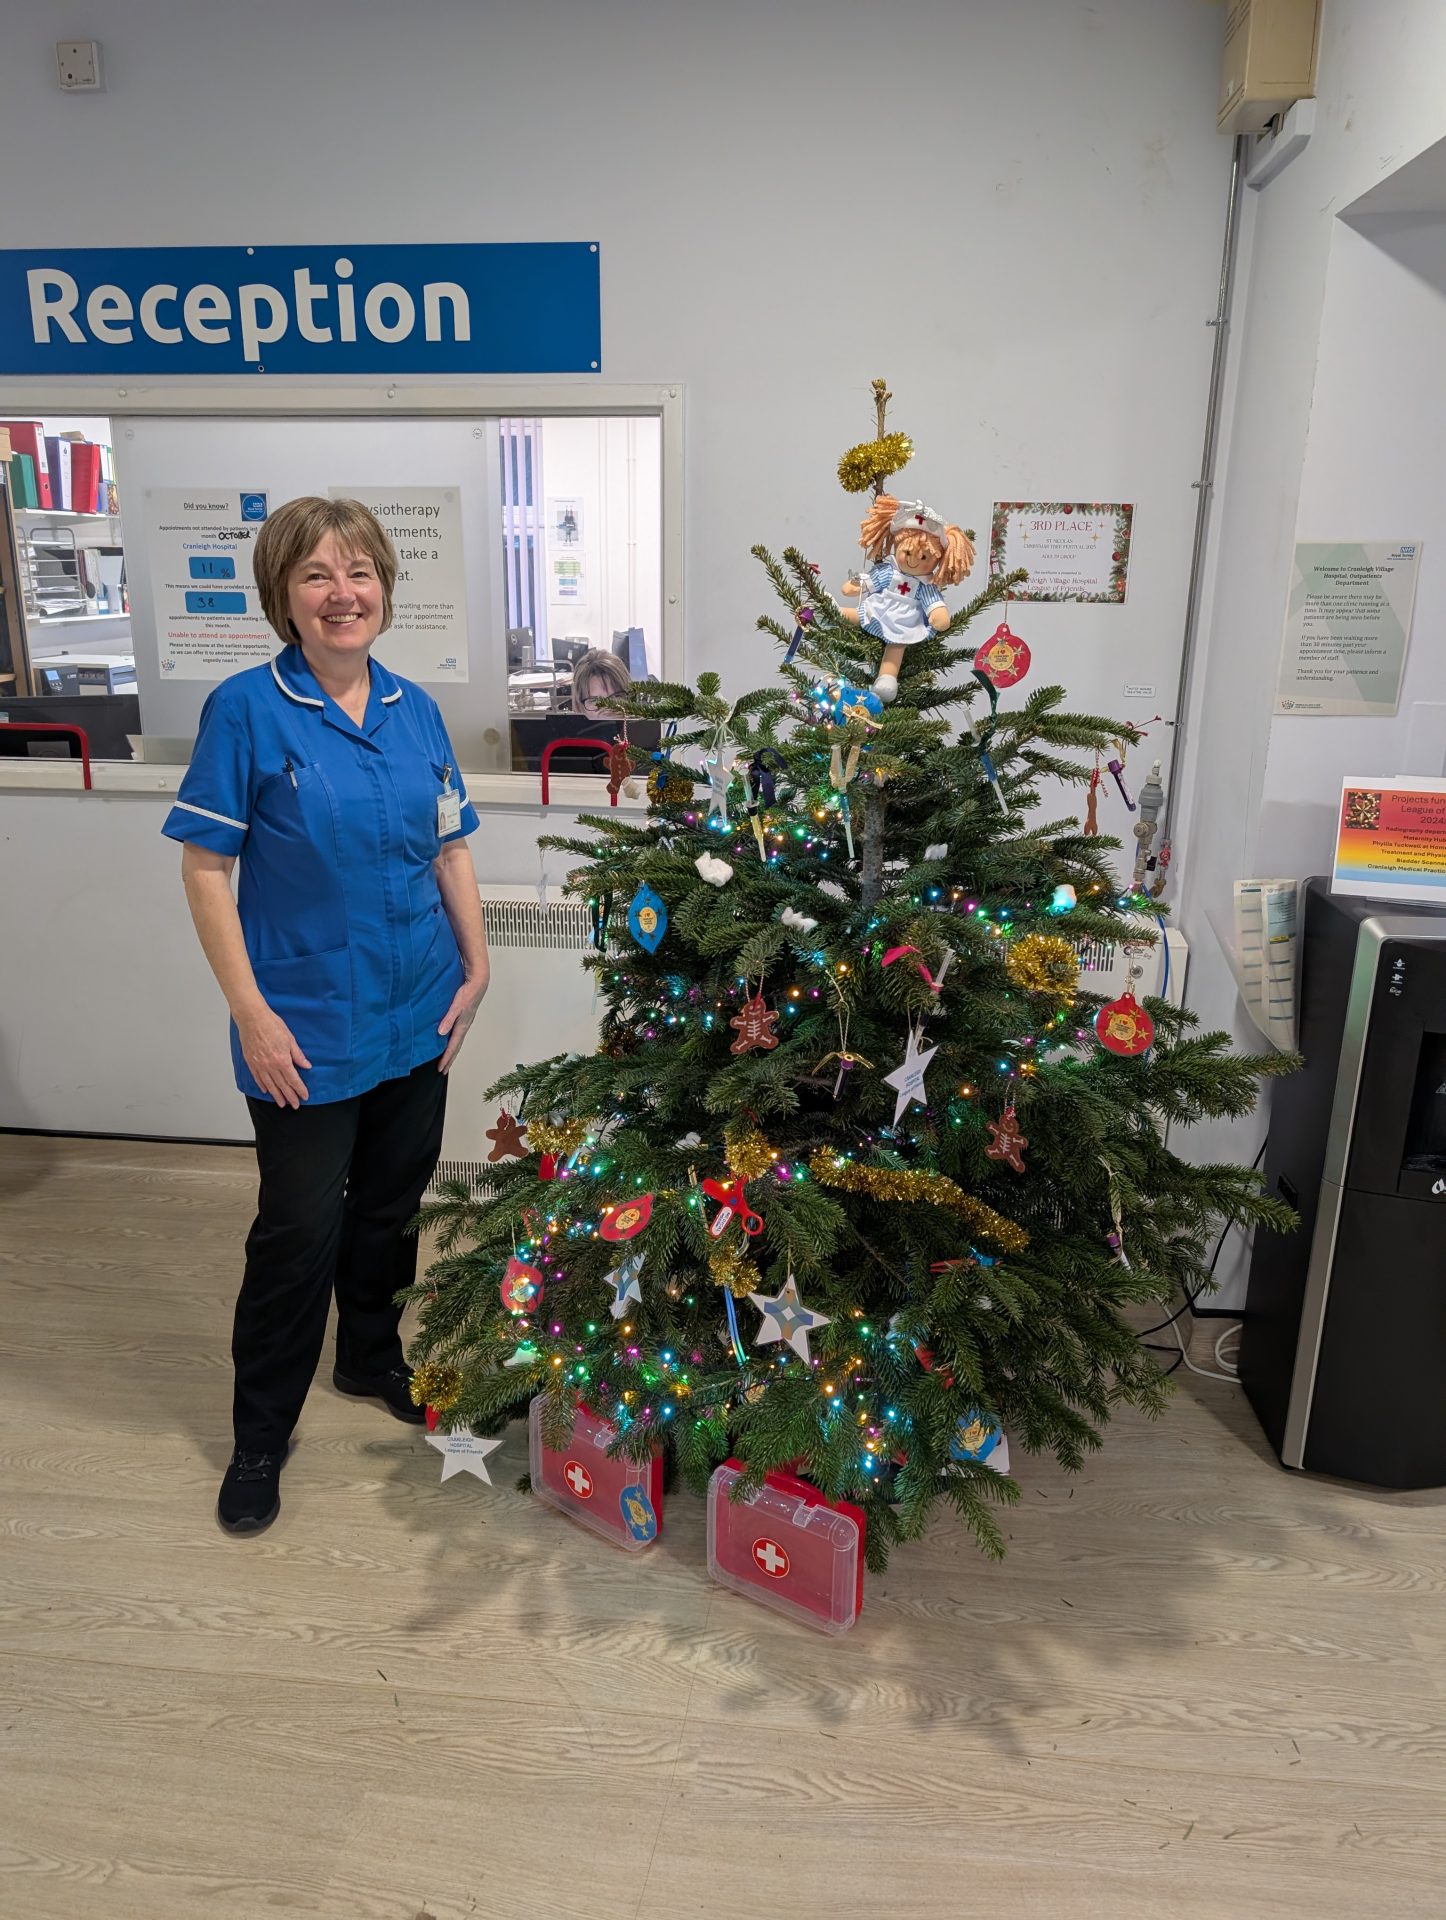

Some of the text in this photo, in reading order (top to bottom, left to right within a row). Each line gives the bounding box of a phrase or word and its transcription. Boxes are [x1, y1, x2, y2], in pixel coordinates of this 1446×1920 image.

[27, 258, 471, 362] Reception
[367, 504, 440, 517] ysiotherapy
[1030, 521, 1092, 531] 3RD PLACE
[218, 531, 251, 540] OCTOBER
[386, 527, 442, 539] ntments,
[400, 548, 427, 559] take
[397, 571, 414, 581] at.
[197, 597, 214, 608] 38
[1392, 795, 1429, 804] Projects
